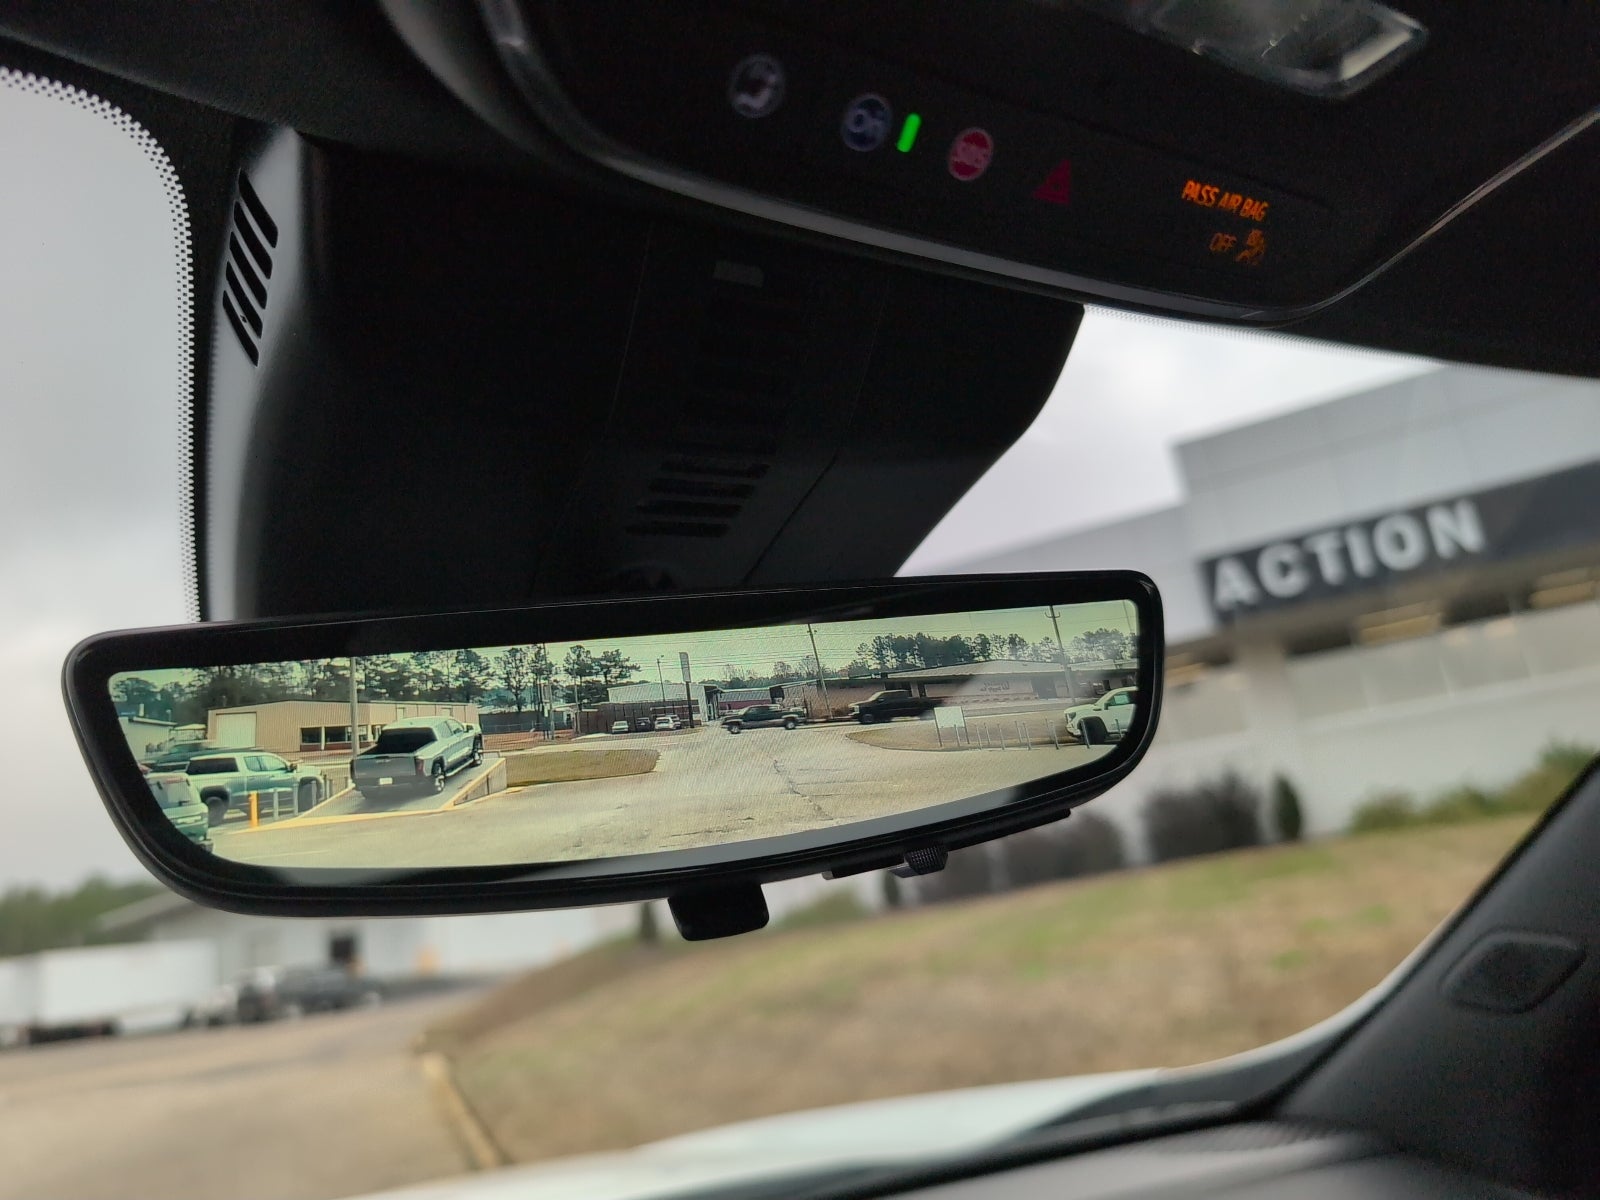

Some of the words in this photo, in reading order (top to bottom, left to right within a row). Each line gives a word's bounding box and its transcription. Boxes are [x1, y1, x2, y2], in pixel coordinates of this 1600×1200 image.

[1183, 181, 1219, 207] PASS
[1219, 193, 1242, 213] AIR
[1241, 199, 1268, 221] BAG
[1210, 233, 1236, 251] OFF
[1215, 501, 1484, 608] ACTION
